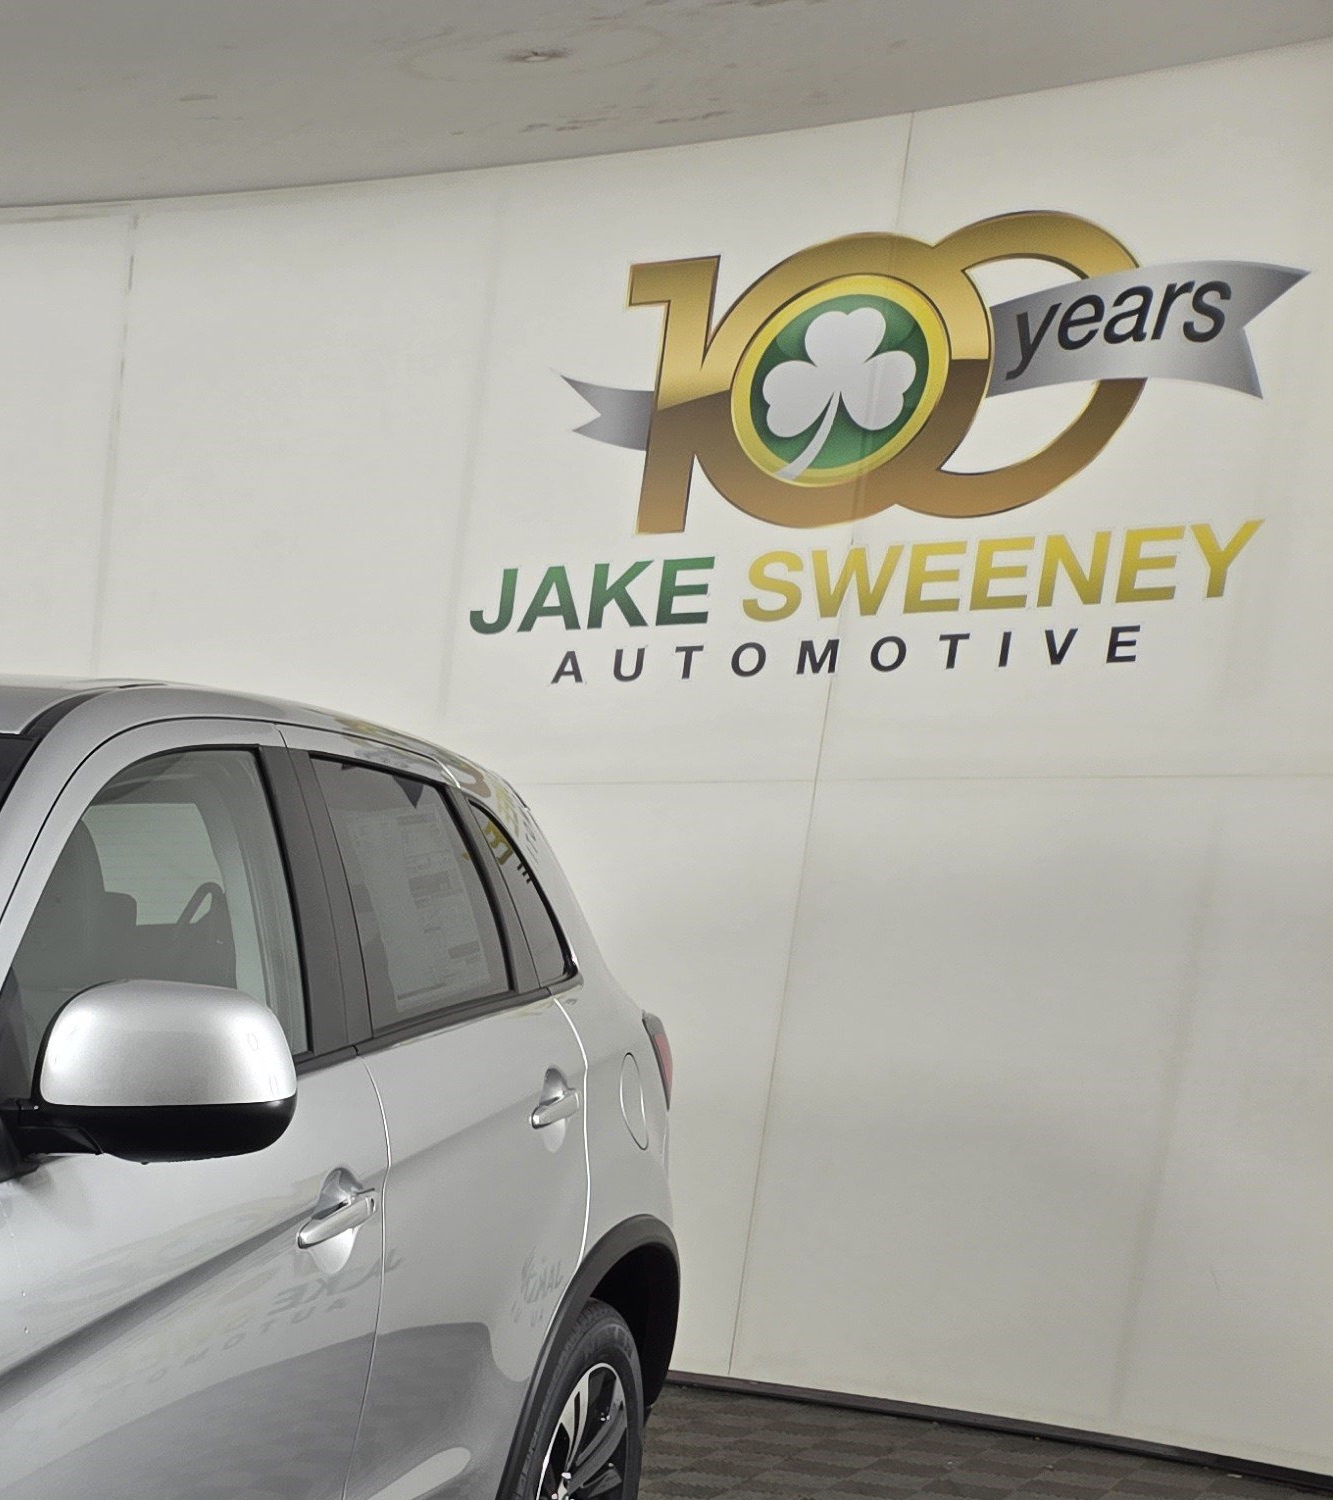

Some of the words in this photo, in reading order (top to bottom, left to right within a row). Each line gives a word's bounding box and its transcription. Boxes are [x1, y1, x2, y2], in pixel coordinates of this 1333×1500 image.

[625, 209, 1149, 535] 100
[1003, 275, 1233, 380] years
[469, 556, 716, 636] JAKE
[742, 519, 1265, 622] SWEENEY
[550, 624, 1141, 686] AUTOMOTIVE
